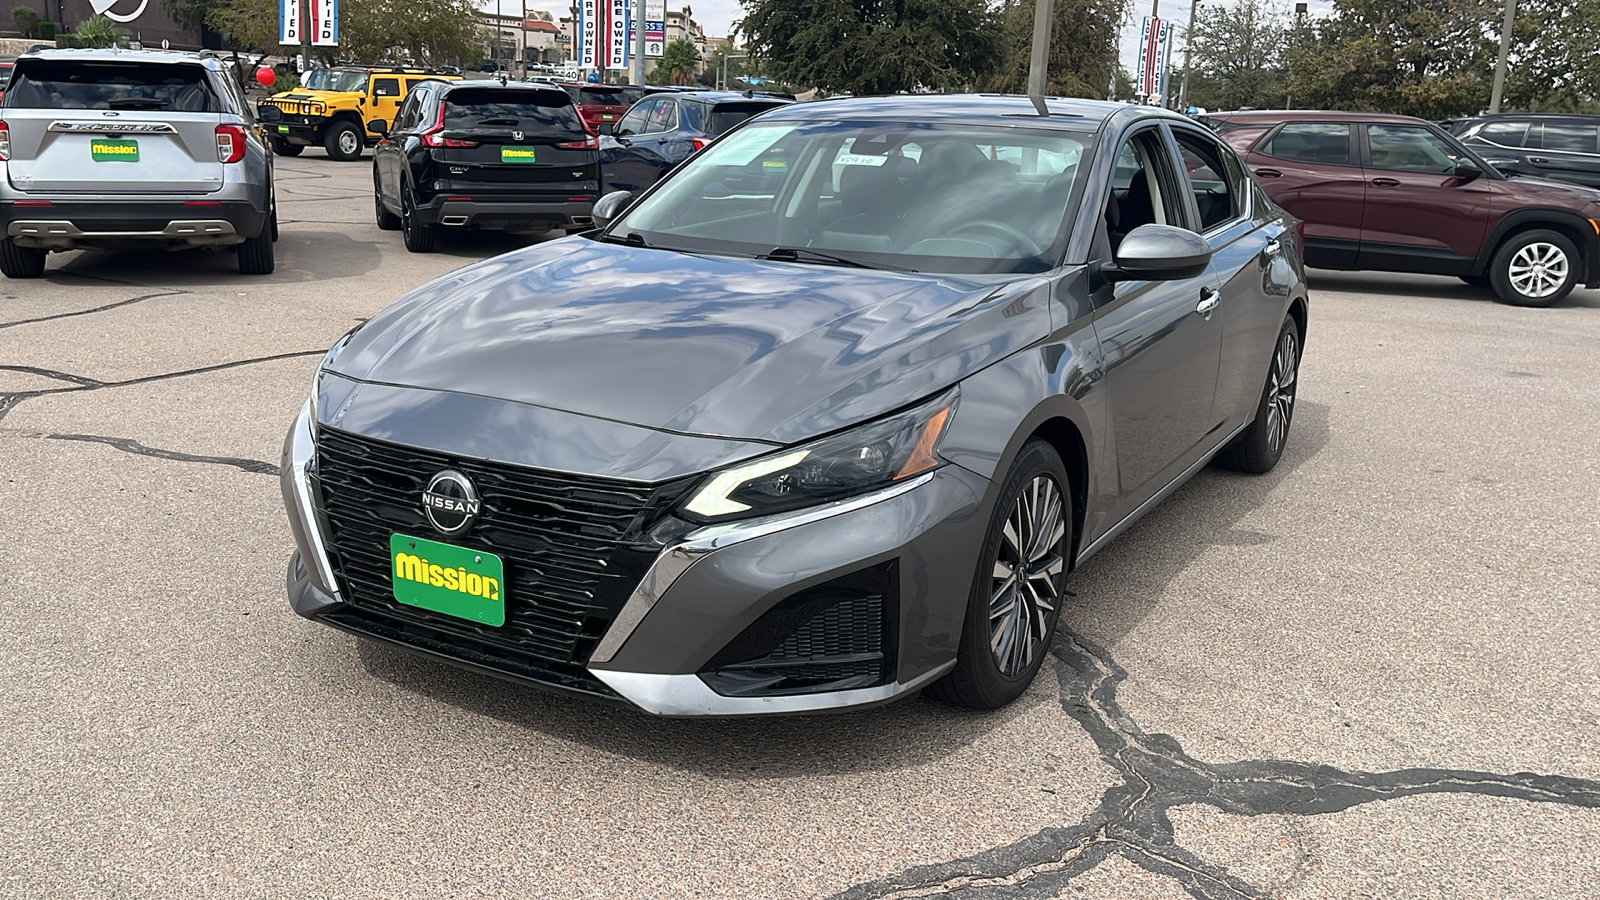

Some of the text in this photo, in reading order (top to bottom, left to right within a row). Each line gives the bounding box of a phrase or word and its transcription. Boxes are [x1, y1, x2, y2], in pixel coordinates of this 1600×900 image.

[584, 21, 594, 64] OWNED
[613, 21, 624, 64] OWNED
[630, 22, 656, 30] RSS
[565, 71, 577, 79] 40
[1139, 47, 1147, 92] PRICES
[1154, 50, 1162, 94] PRICES
[422, 492, 478, 514] NISSAN
